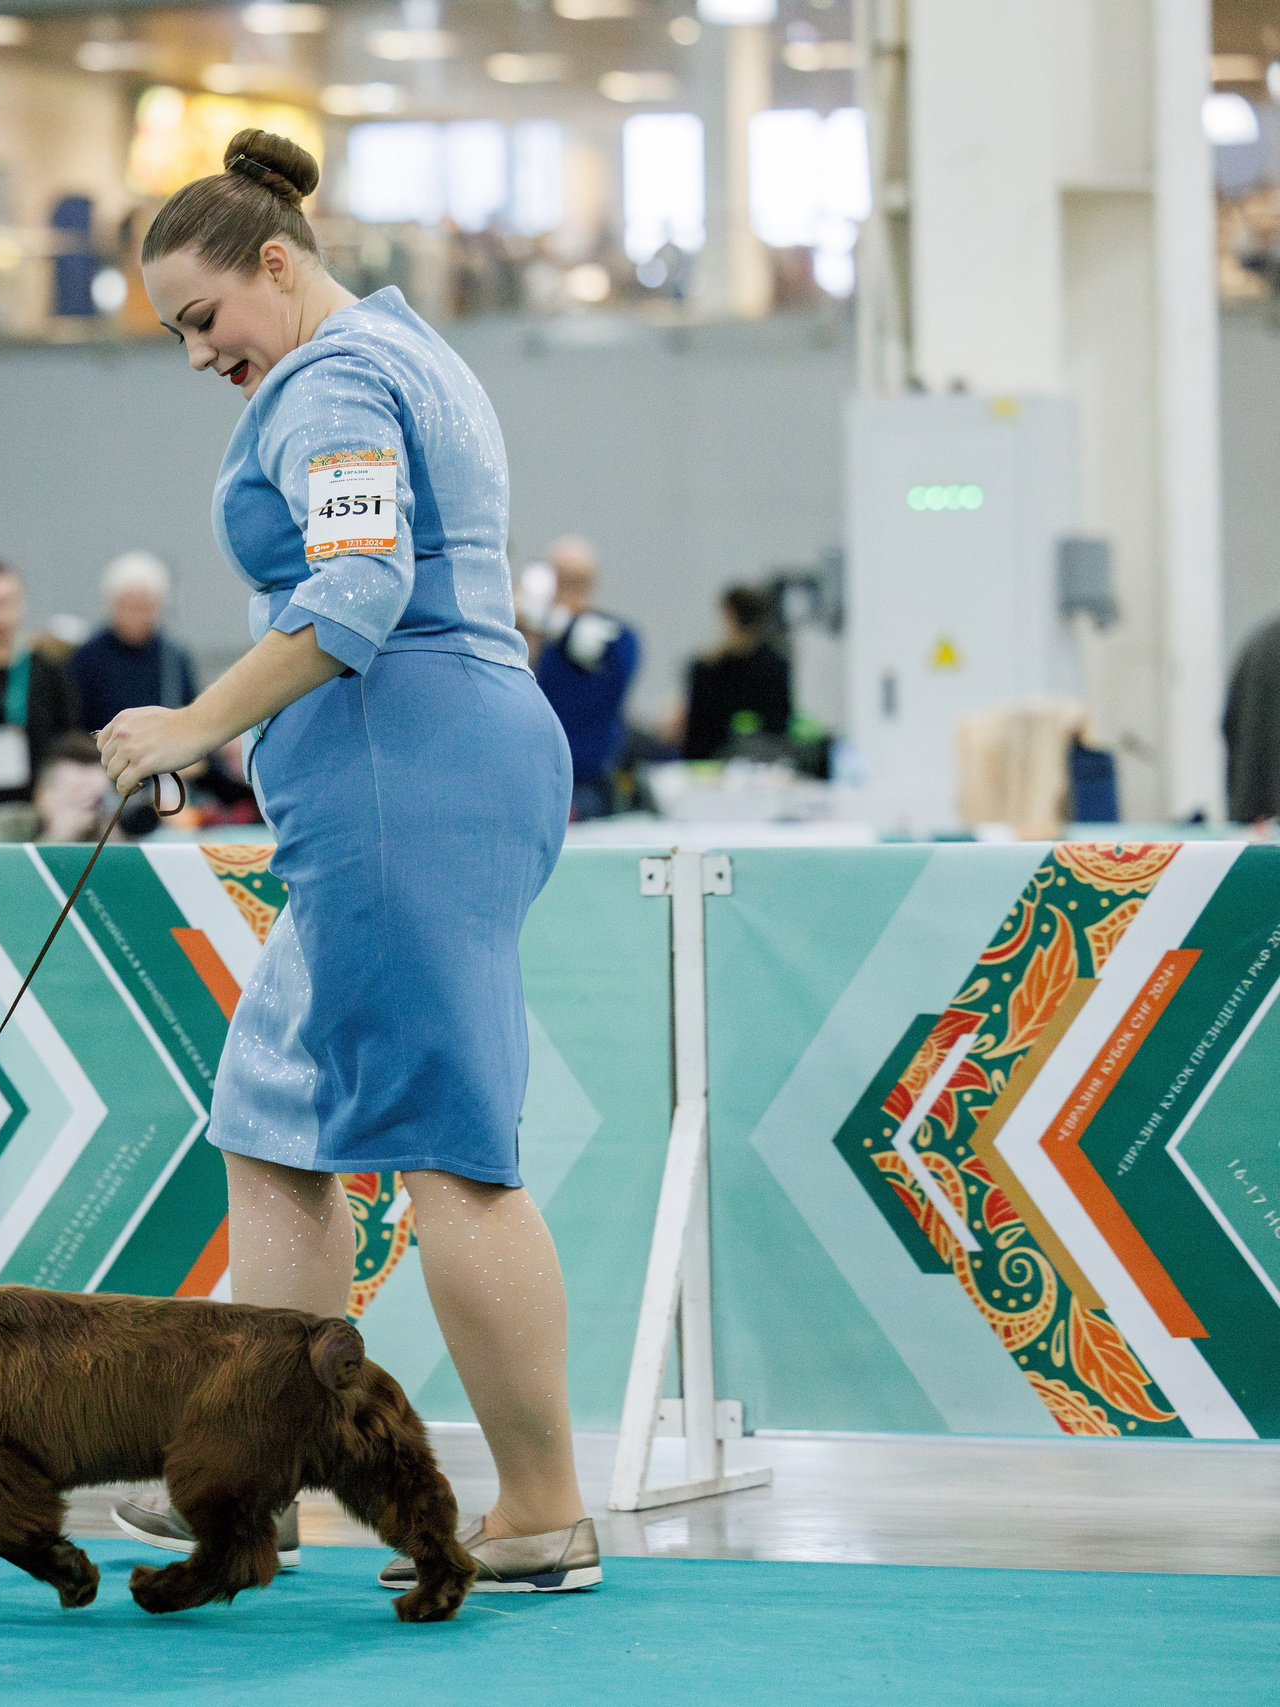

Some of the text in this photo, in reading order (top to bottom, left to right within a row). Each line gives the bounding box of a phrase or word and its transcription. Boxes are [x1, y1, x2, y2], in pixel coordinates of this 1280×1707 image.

[318, 495, 381, 519] 4351
[1101, 1029, 1132, 1074] КУБОК
[1131, 1000, 1151, 1029] СНГ
[1161, 1065, 1193, 1109] КУБОК
[1191, 977, 1251, 1065] ПРЕЗИДЕНТА
[1249, 947, 1271, 977] РКФ
[1227, 1159, 1267, 1203] 16-17
